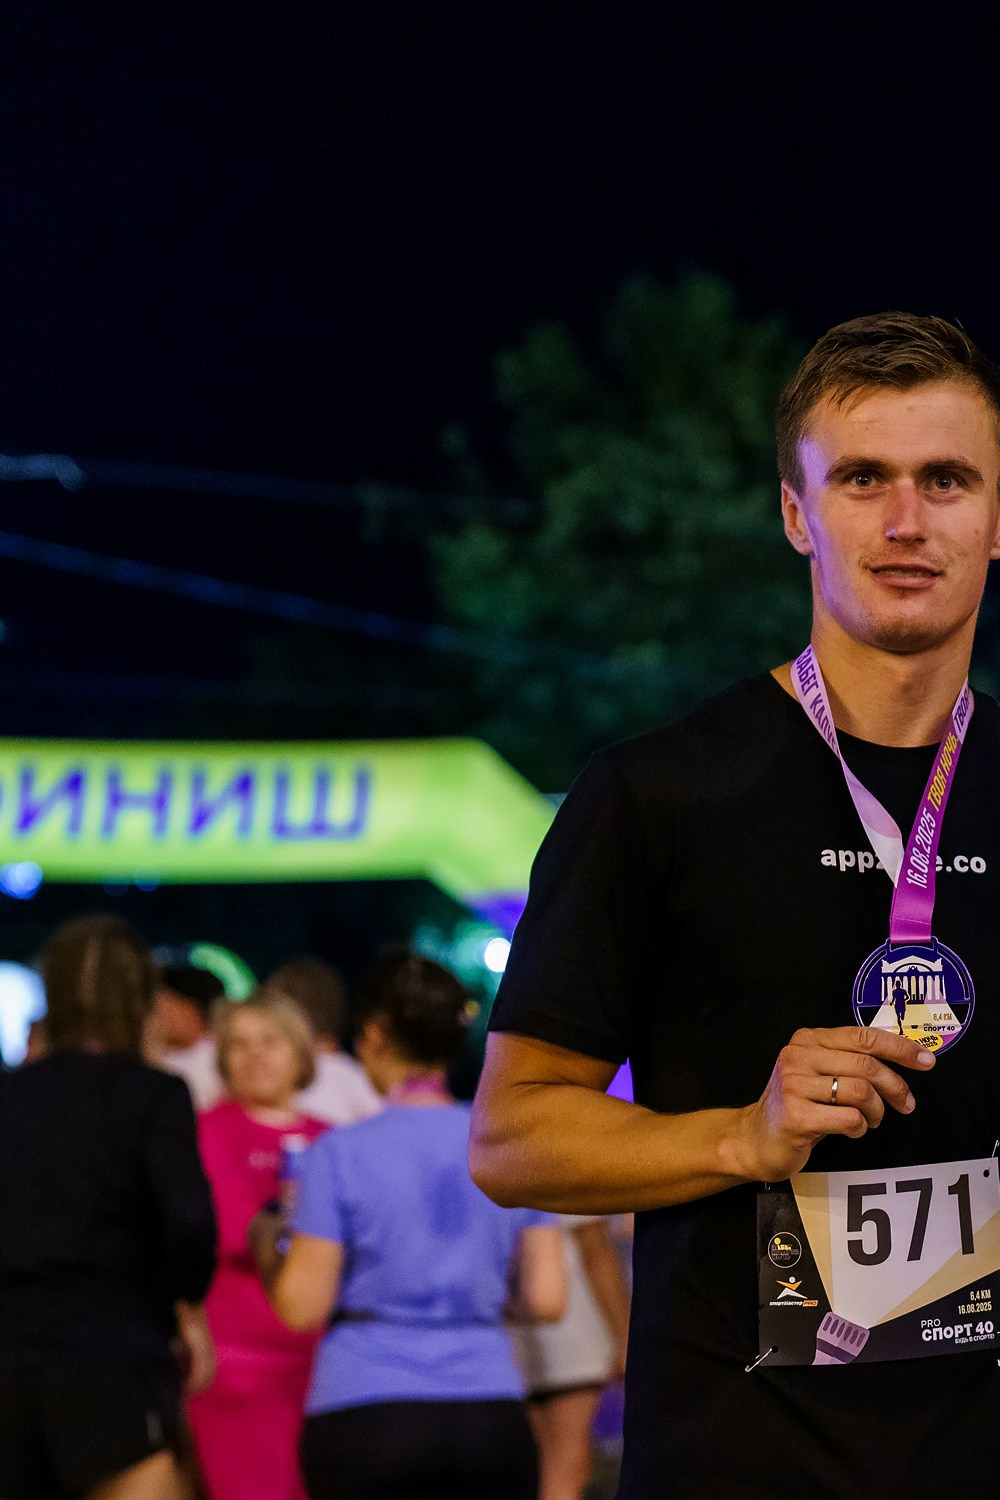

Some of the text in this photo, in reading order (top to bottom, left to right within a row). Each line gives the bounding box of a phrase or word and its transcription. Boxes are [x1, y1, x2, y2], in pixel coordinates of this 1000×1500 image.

[796, 648, 819, 697] ЗАБЕГ
[0, 758, 373, 841] ИНИШ
[905, 807, 937, 889] 16.08.2025
[927, 765, 947, 812] ТВОЯ
[846, 1173, 975, 1266] 571
[957, 1301, 993, 1315] 16.08.2025
[970, 1290, 980, 1301] 6,4
[920, 1318, 941, 1329] PRO
[921, 1320, 994, 1342] СПОРТ 40
